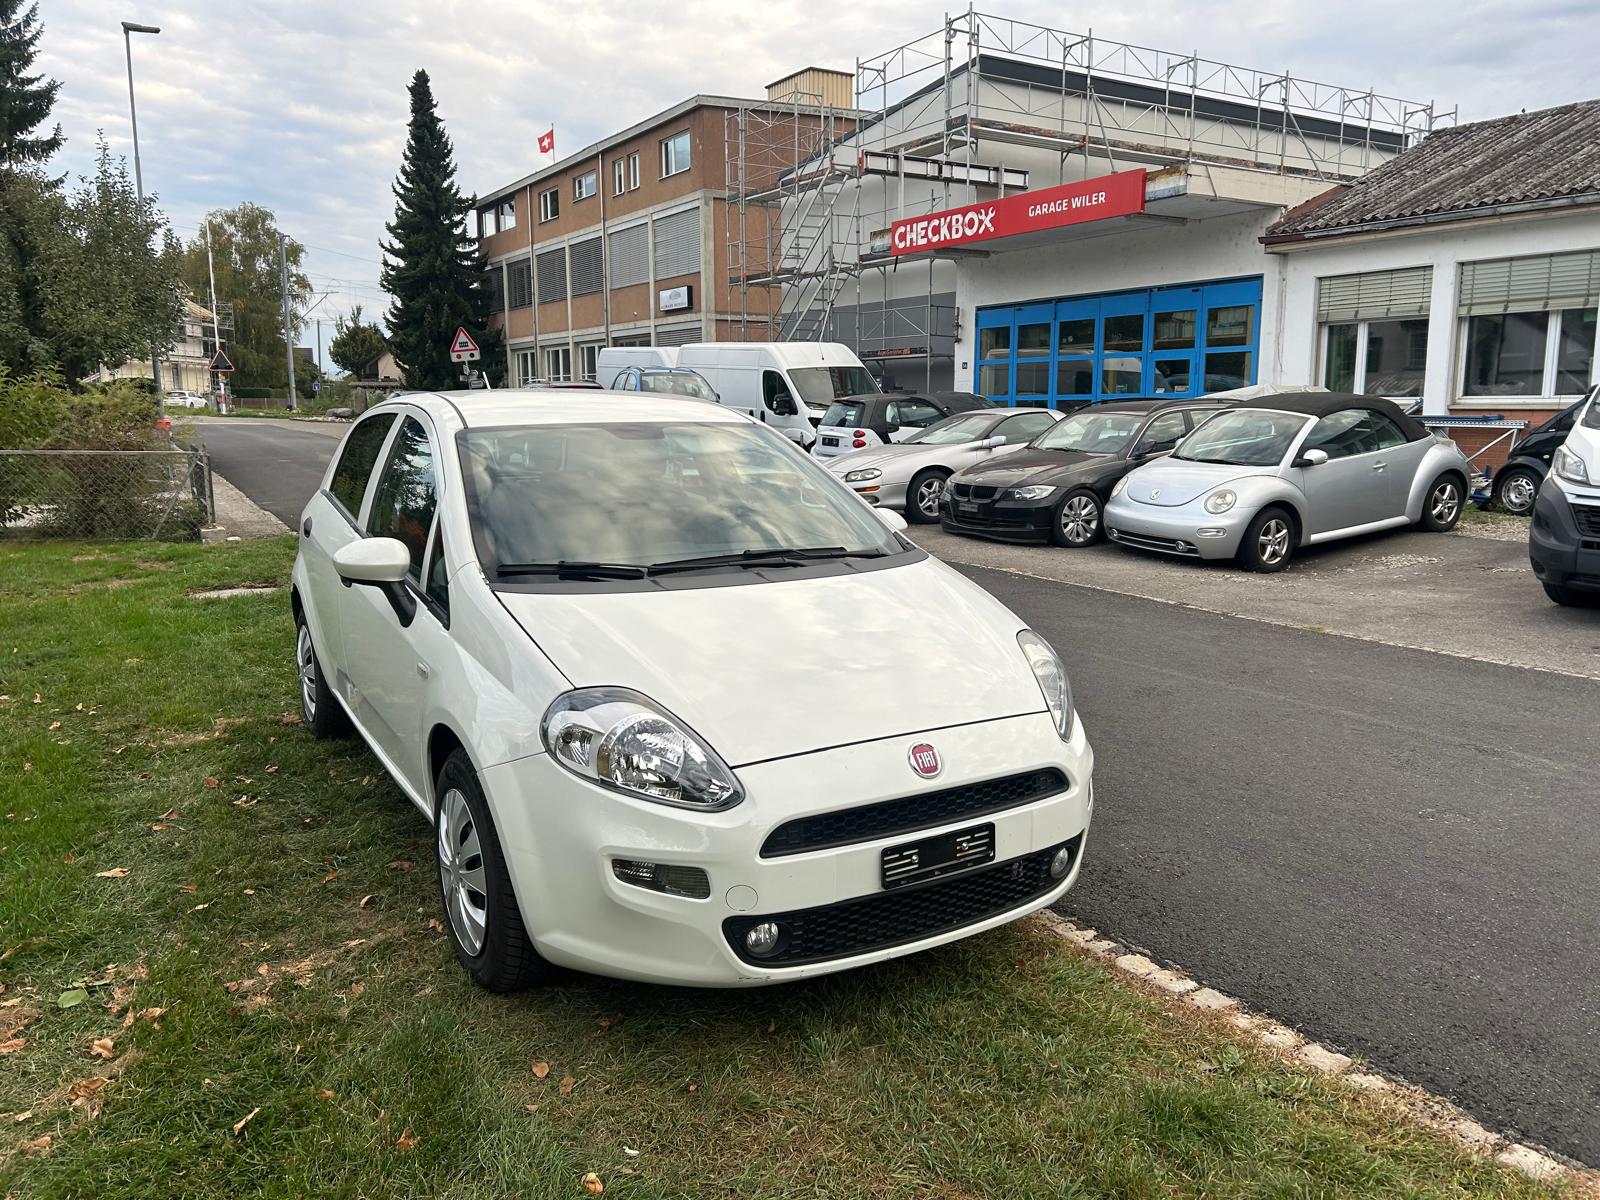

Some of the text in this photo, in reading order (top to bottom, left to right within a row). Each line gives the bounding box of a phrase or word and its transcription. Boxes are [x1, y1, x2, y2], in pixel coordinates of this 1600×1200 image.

[1028, 191, 1107, 217] GARAGE WILER
[894, 206, 996, 249] CHECKBOX
[916, 751, 935, 769] FIAT
